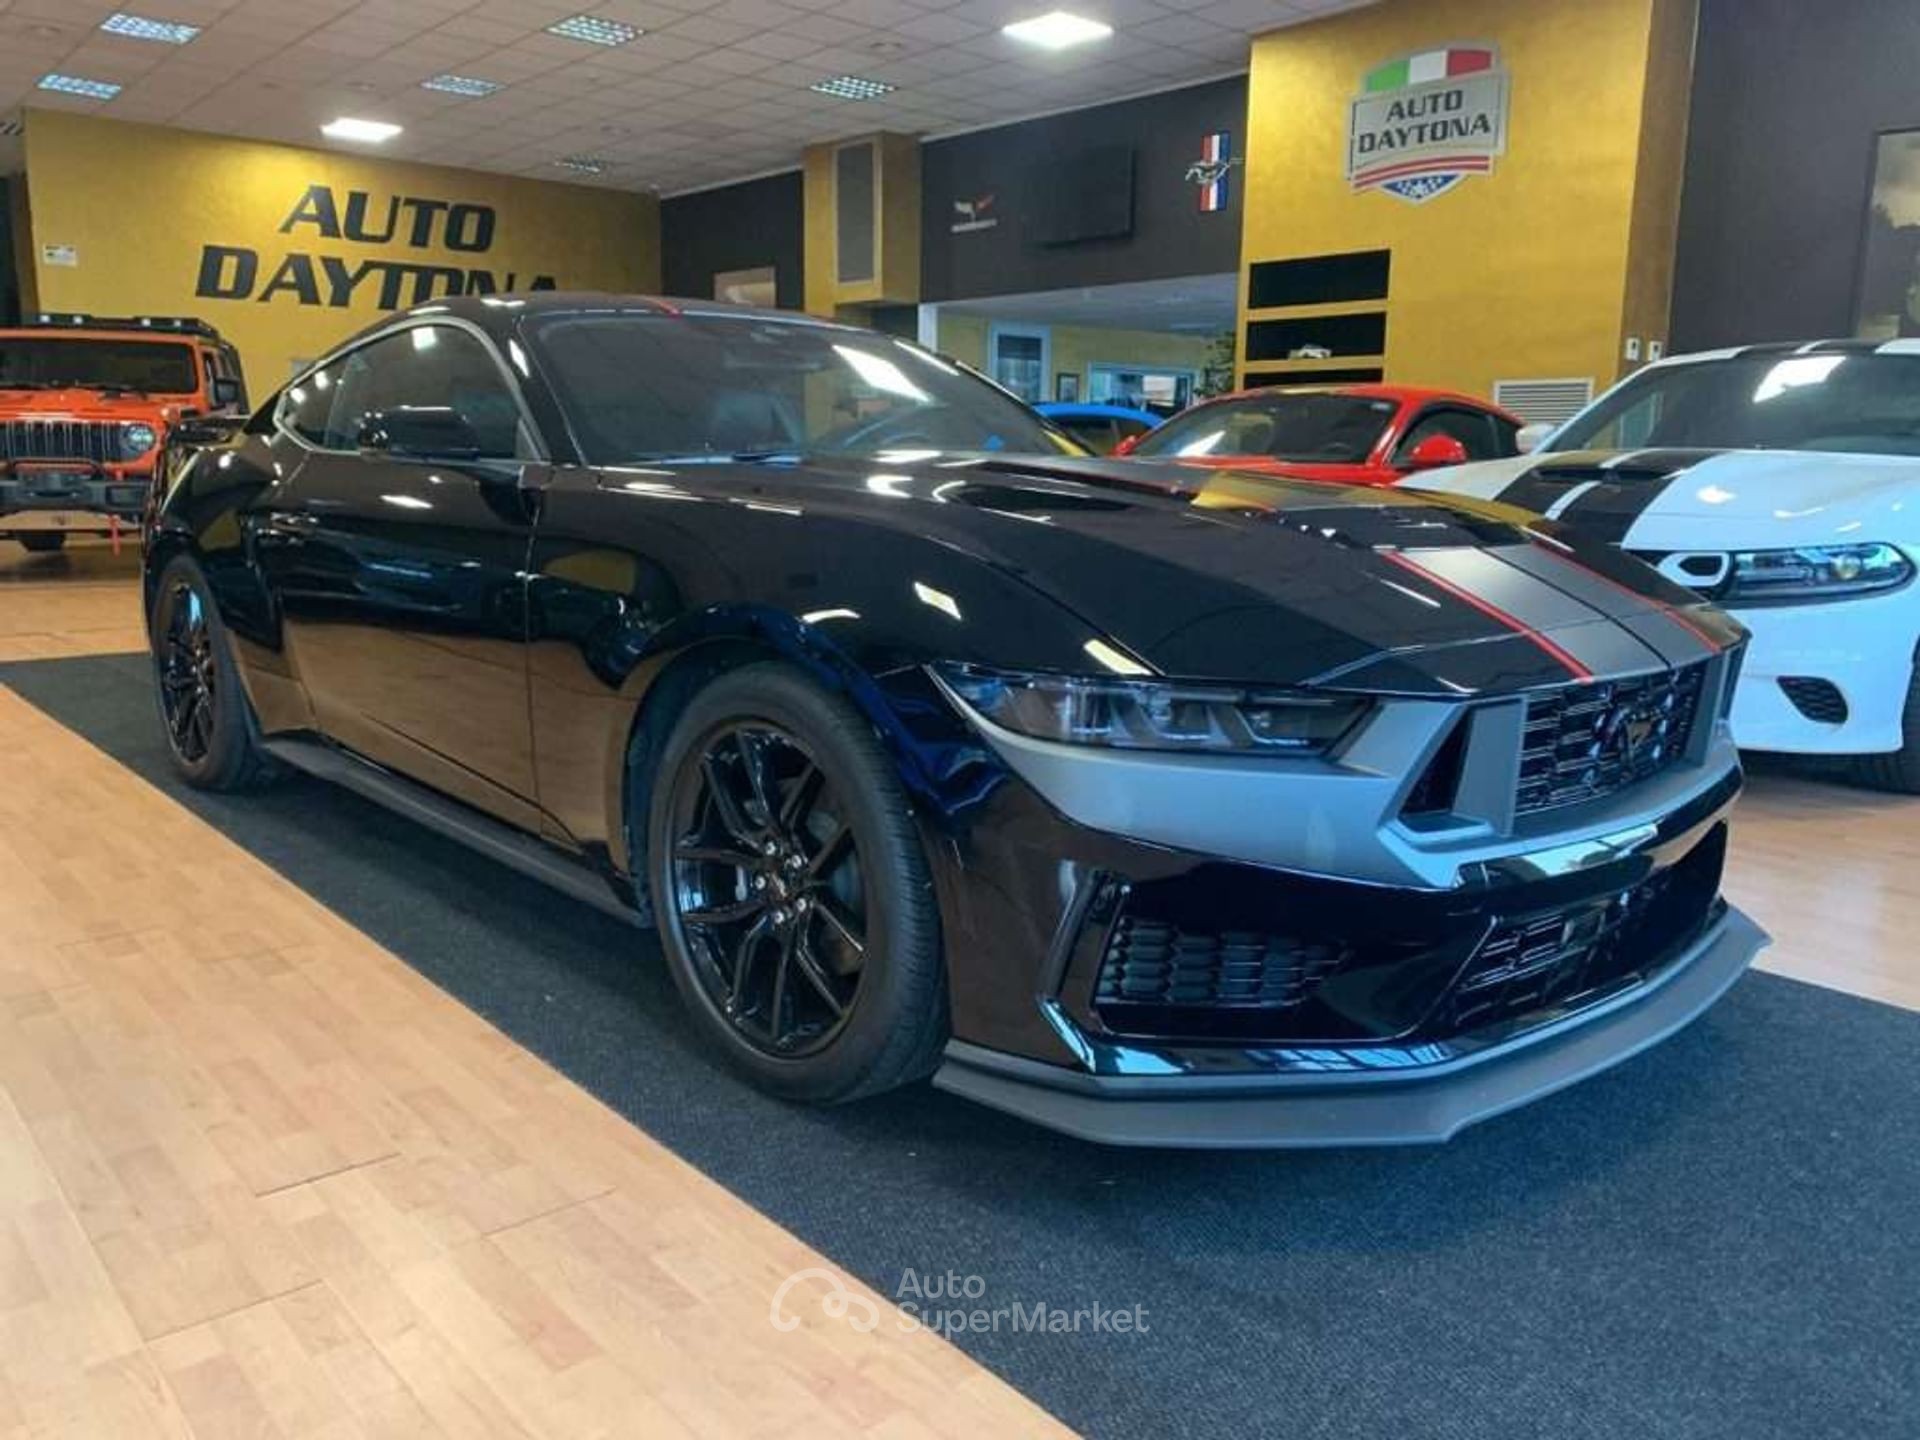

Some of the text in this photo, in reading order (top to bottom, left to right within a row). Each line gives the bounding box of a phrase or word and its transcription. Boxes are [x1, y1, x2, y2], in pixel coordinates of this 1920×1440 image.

[1358, 113, 1491, 152] DAYTONA
[1386, 90, 1463, 122] AUTO
[279, 184, 496, 253] AUTO
[195, 244, 557, 311] DAYTON
